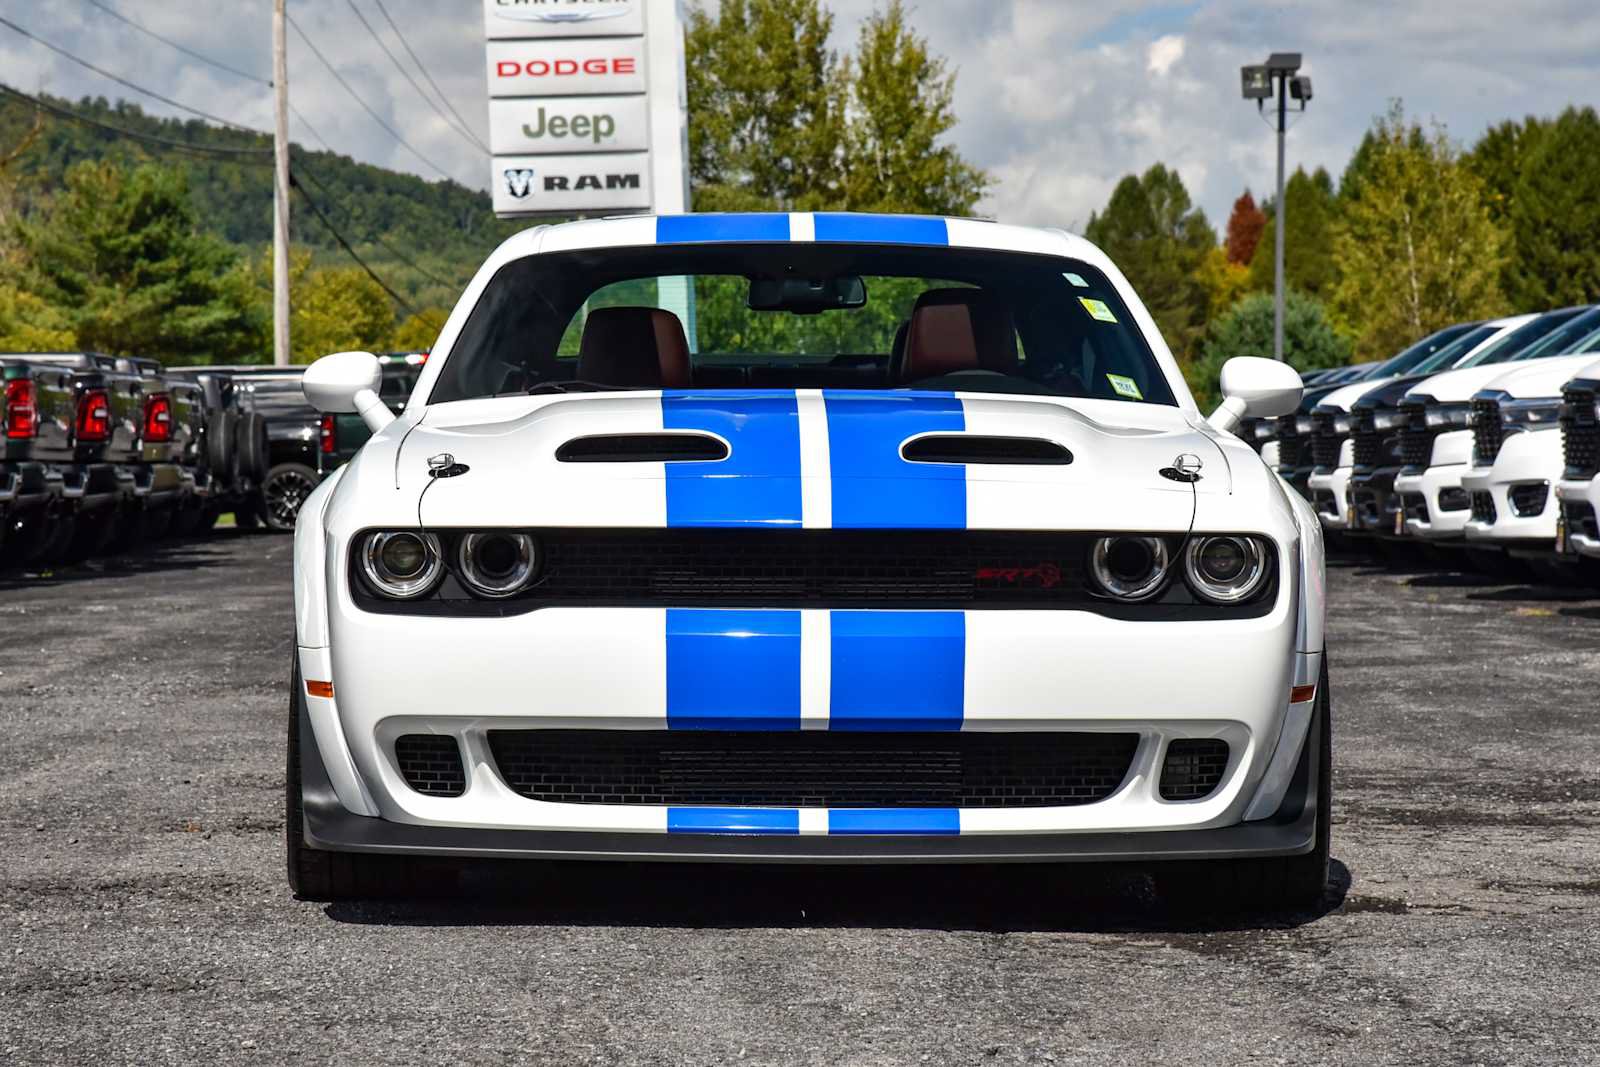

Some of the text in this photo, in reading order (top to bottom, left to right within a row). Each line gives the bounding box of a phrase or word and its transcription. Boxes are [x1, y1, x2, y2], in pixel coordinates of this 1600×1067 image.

[497, 58, 635, 77] DODGE
[522, 107, 615, 144] Jeep
[543, 174, 640, 191] RAM
